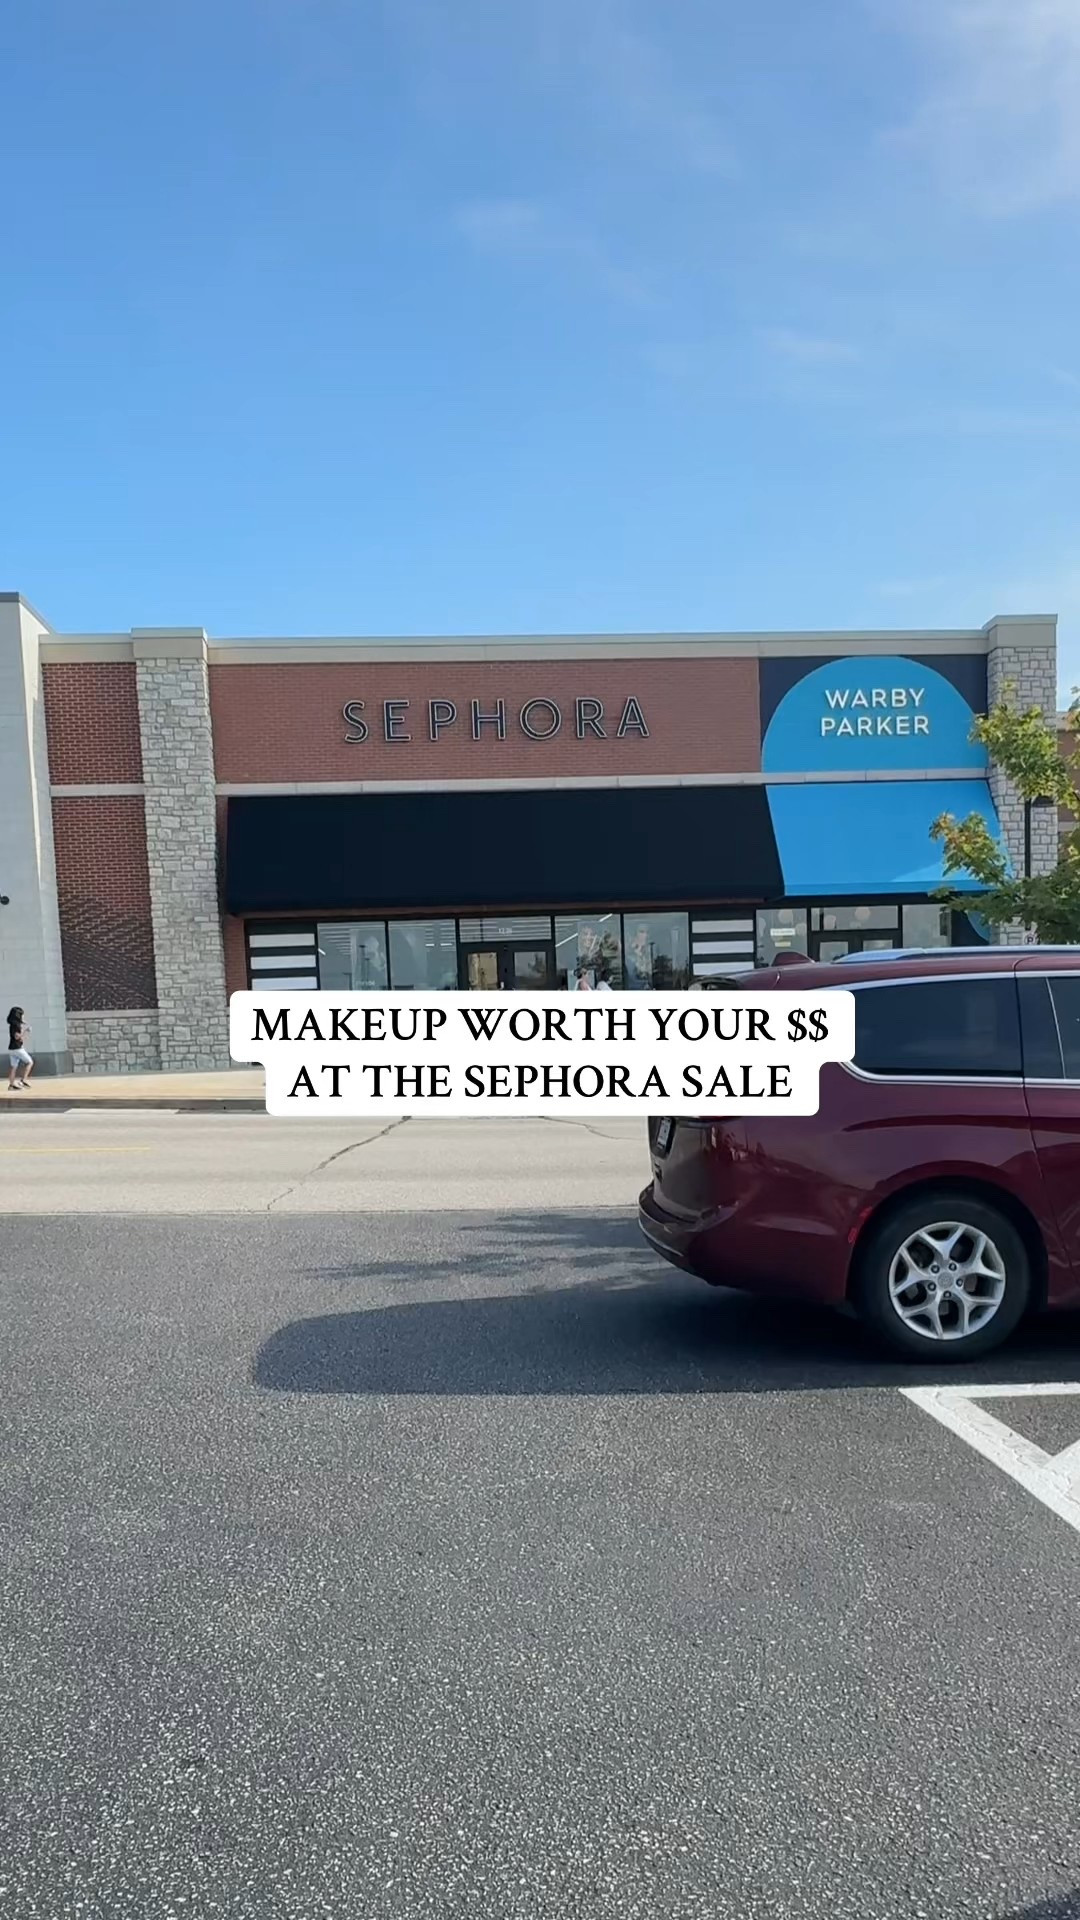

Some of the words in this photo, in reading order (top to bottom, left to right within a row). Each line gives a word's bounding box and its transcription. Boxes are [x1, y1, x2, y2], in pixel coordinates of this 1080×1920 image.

[825, 688, 925, 709] WARBY
[343, 696, 650, 743] SEPHORA
[821, 715, 930, 736] PARKER
